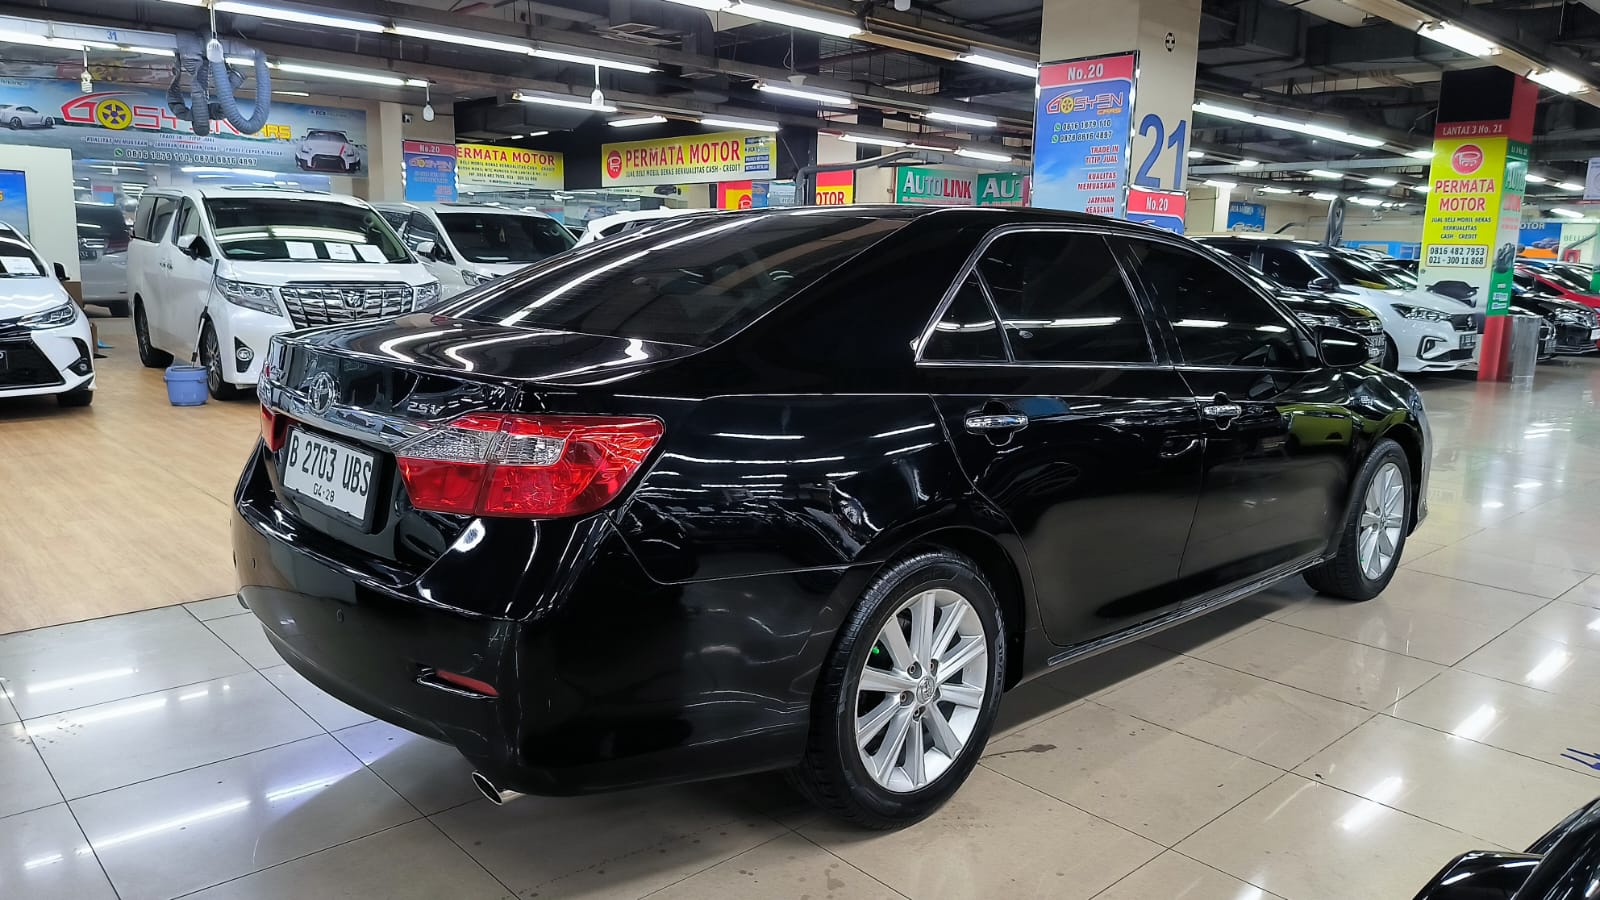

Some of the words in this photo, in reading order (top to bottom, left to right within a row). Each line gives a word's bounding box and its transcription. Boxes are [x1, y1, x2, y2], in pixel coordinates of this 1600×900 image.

[1067, 63, 1104, 81] No.20
[1443, 126, 1470, 136] LANTAI
[1471, 125, 1477, 134] 3
[1492, 124, 1503, 133] 21
[625, 145, 684, 168] PERMATA
[690, 140, 741, 164] MOTOR
[1091, 146, 1110, 154] TRADE
[1112, 145, 1119, 153] IN
[1134, 113, 1187, 190] 21
[456, 147, 507, 162] ERMATA
[512, 152, 555, 166] MOTOR
[1086, 156, 1101, 164] TITIP
[1103, 155, 1118, 163] JUAL
[706, 165, 719, 174] CASH
[1088, 172, 1117, 180] KUALITAS
[1077, 182, 1116, 191] MEMUASKAN
[1434, 179, 1495, 194] PERMATA
[816, 191, 845, 205] OTOR
[1087, 196, 1115, 204] JAMINAN
[1146, 195, 1169, 211] No.20
[1439, 197, 1486, 211] MOTOR
[1085, 206, 1114, 214] KEASLIAN
[1519, 222, 1546, 230] OTOR
[1430, 247, 1448, 255] 0816
[1450, 247, 1464, 256] 482
[1466, 247, 1485, 256] 7953
[1428, 256, 1441, 264] 021
[1447, 256, 1460, 264] 300
[1461, 257, 1469, 265] 11
[289, 435, 300, 468] B
[302, 440, 338, 482] 2703
[342, 454, 372, 496] UBS
